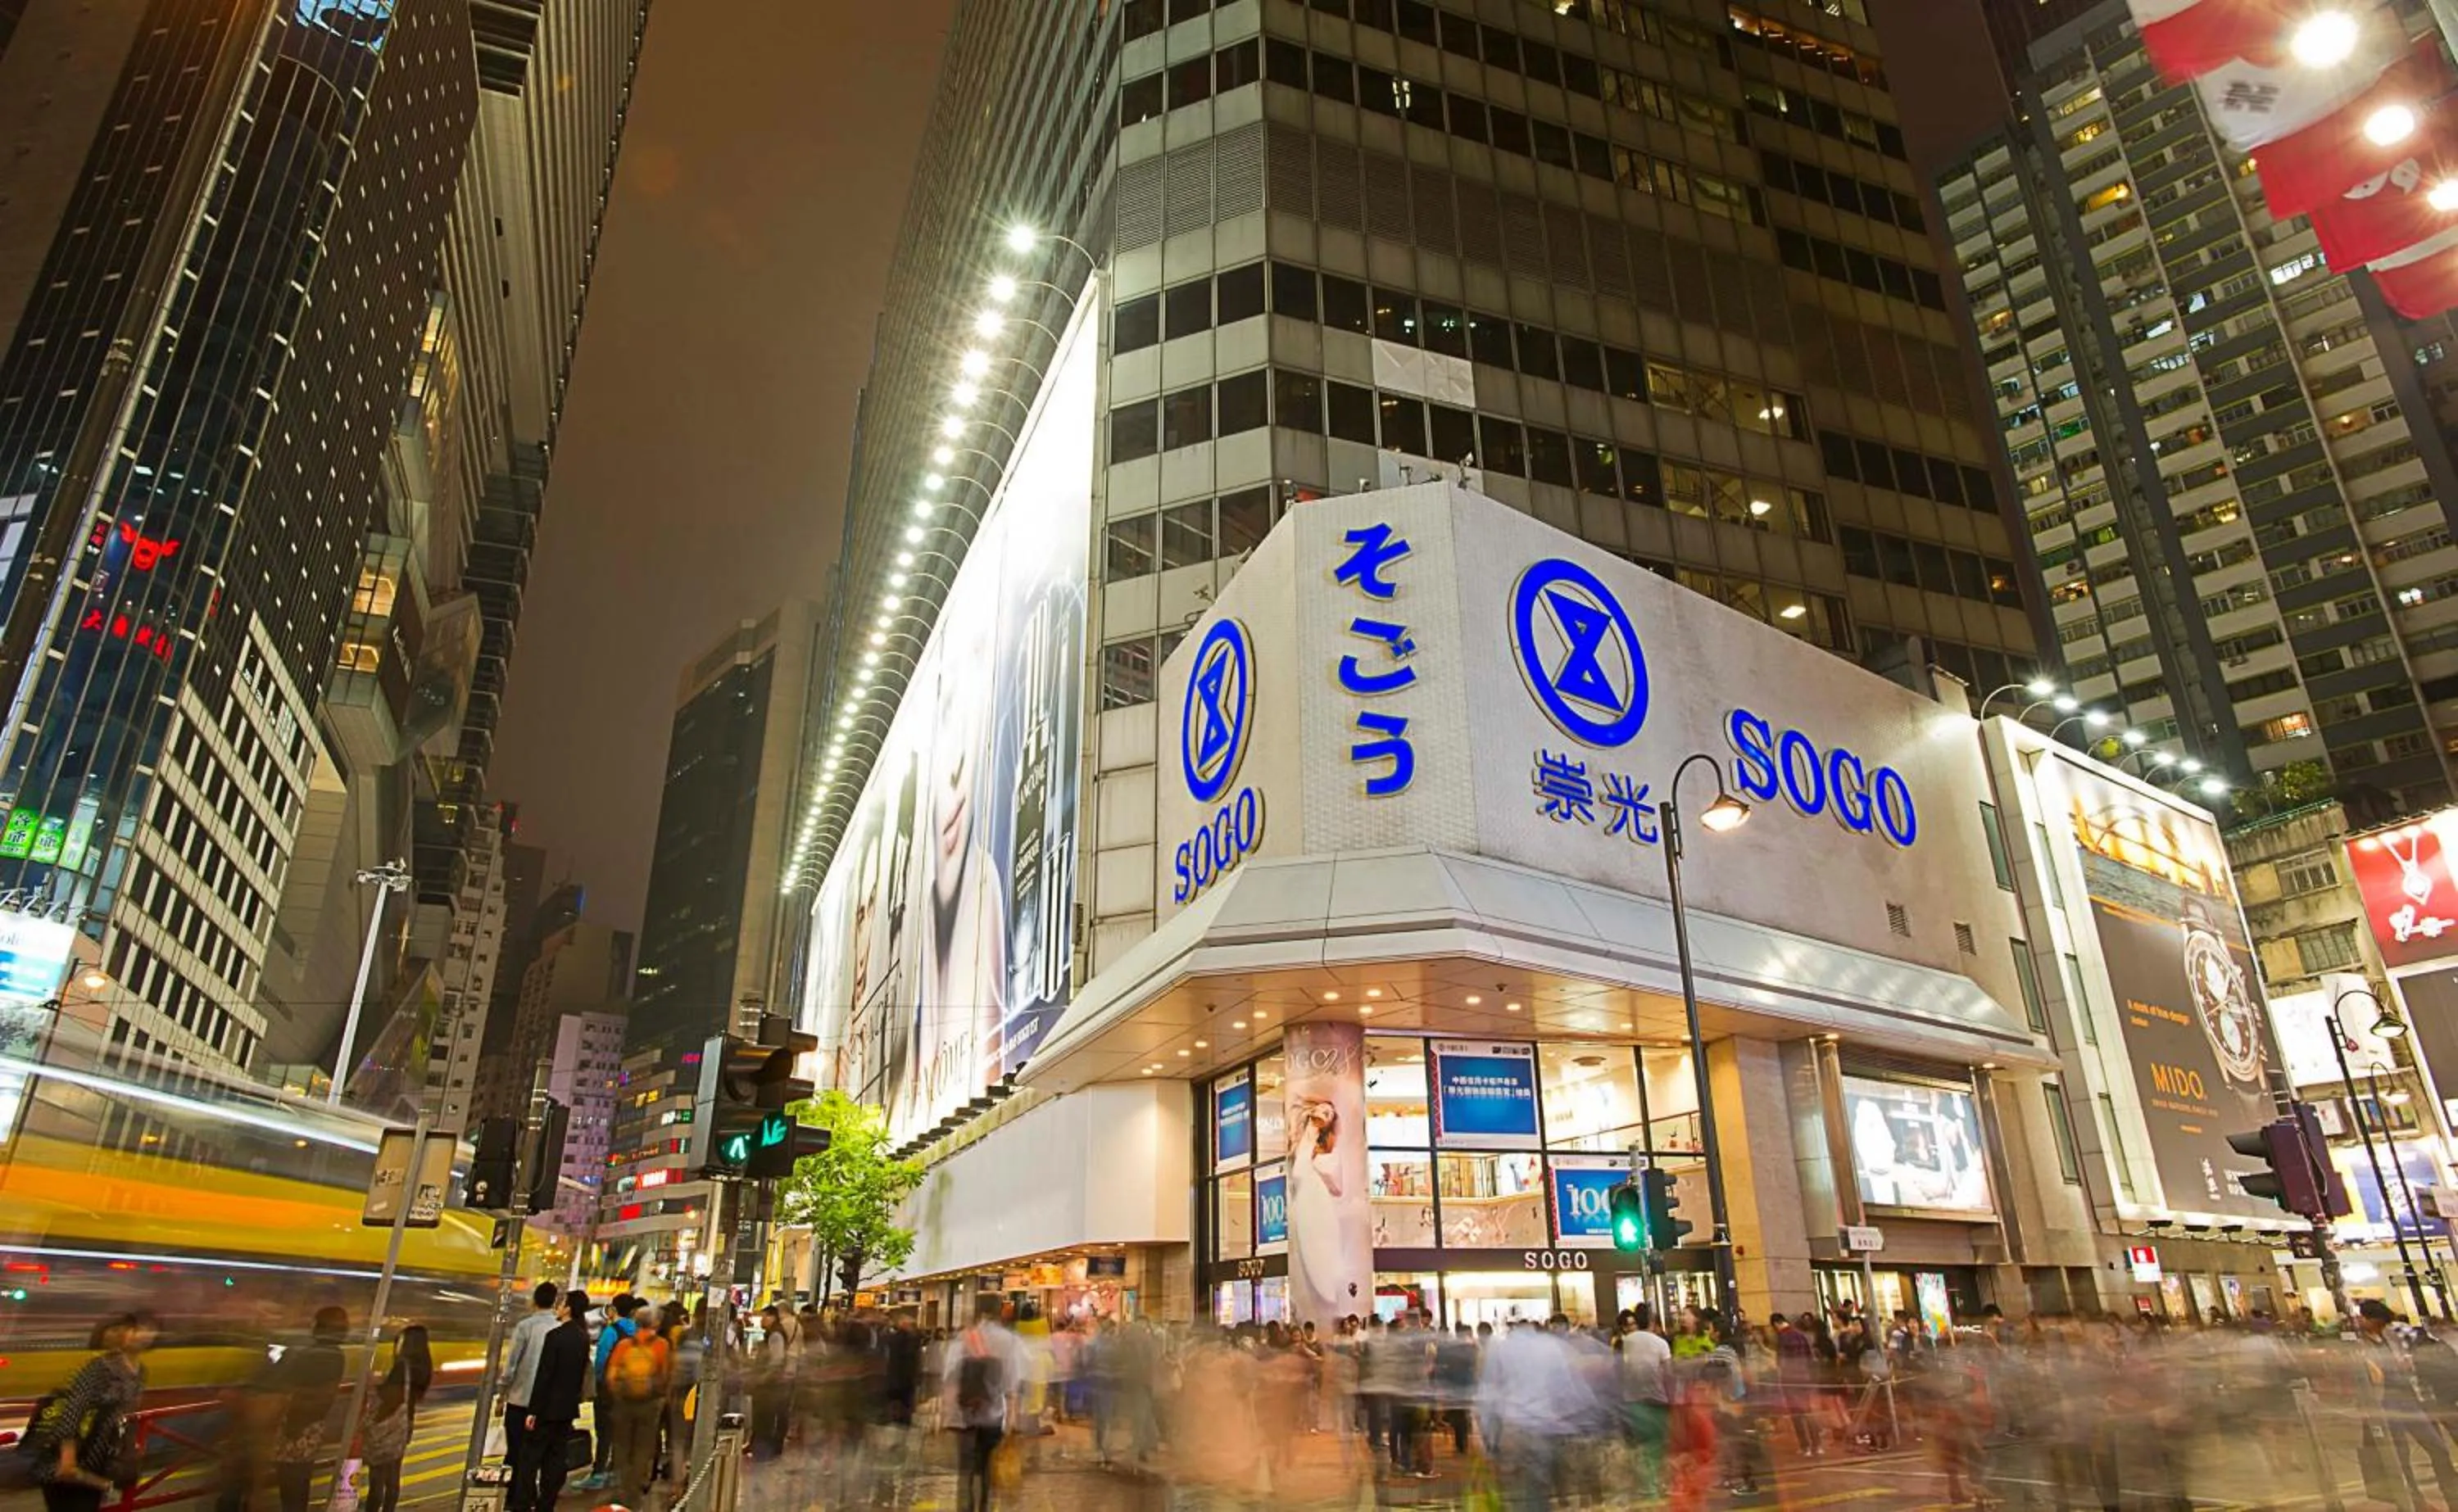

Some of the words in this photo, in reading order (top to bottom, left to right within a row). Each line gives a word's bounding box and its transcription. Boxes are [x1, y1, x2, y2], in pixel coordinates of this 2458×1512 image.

[1332, 522, 1418, 796] そごう
[1533, 748, 1658, 844] 崇光
[1725, 708, 1917, 849] SOGO
[1174, 786, 1263, 904] SOGO
[2151, 1062, 2204, 1101] MIDO
[1524, 1250, 1588, 1270] SOGO
